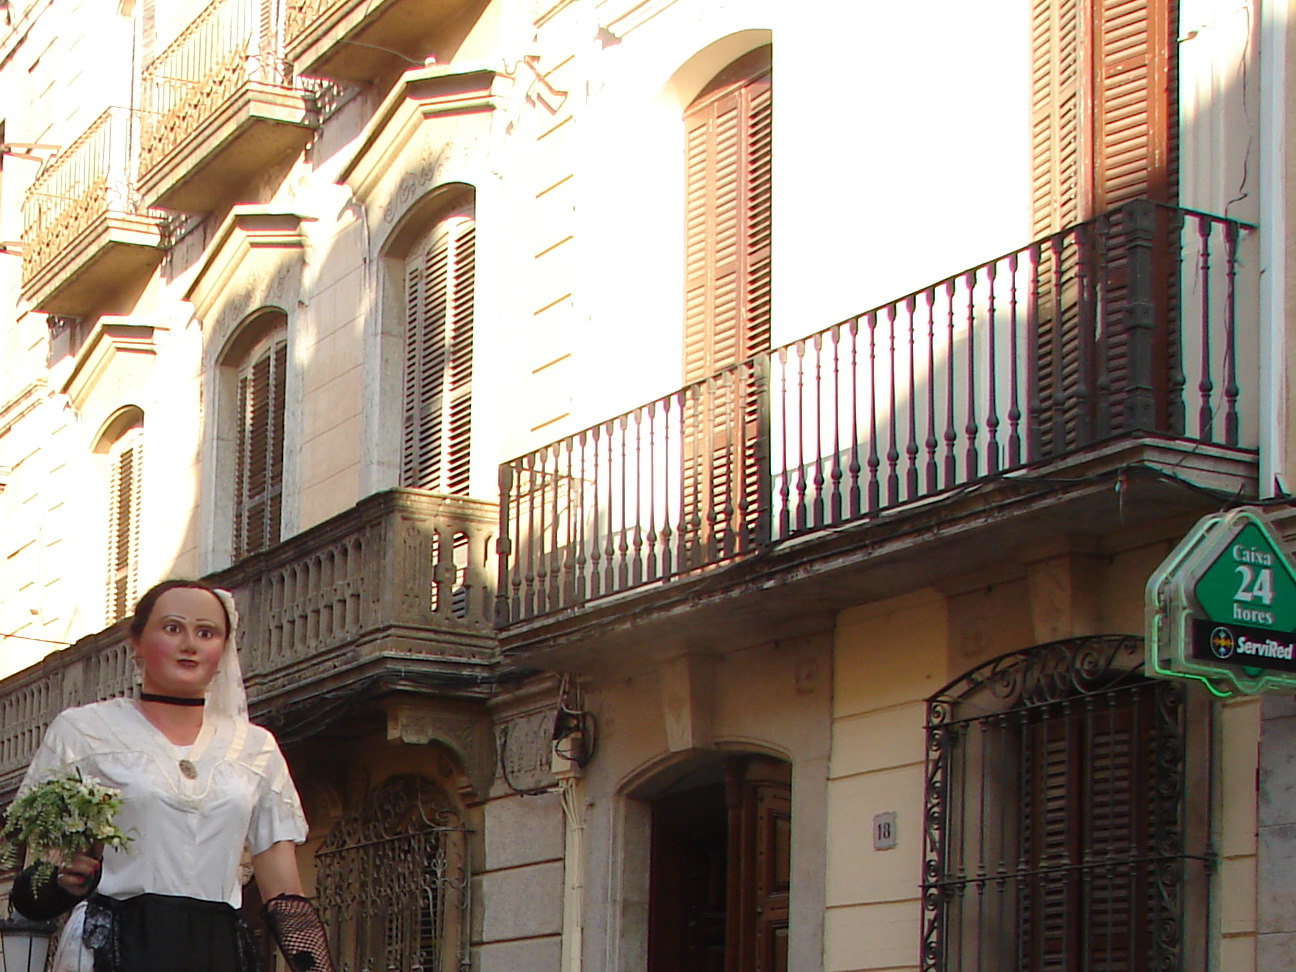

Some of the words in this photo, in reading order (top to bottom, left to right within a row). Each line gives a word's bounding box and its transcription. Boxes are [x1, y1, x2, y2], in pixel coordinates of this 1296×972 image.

[1232, 544, 1272, 566] Caixa
[1233, 564, 1273, 605] 24
[1232, 602, 1274, 624] hores
[1236, 636, 1293, 660] ServiRed
[878, 822, 891, 840] 18
